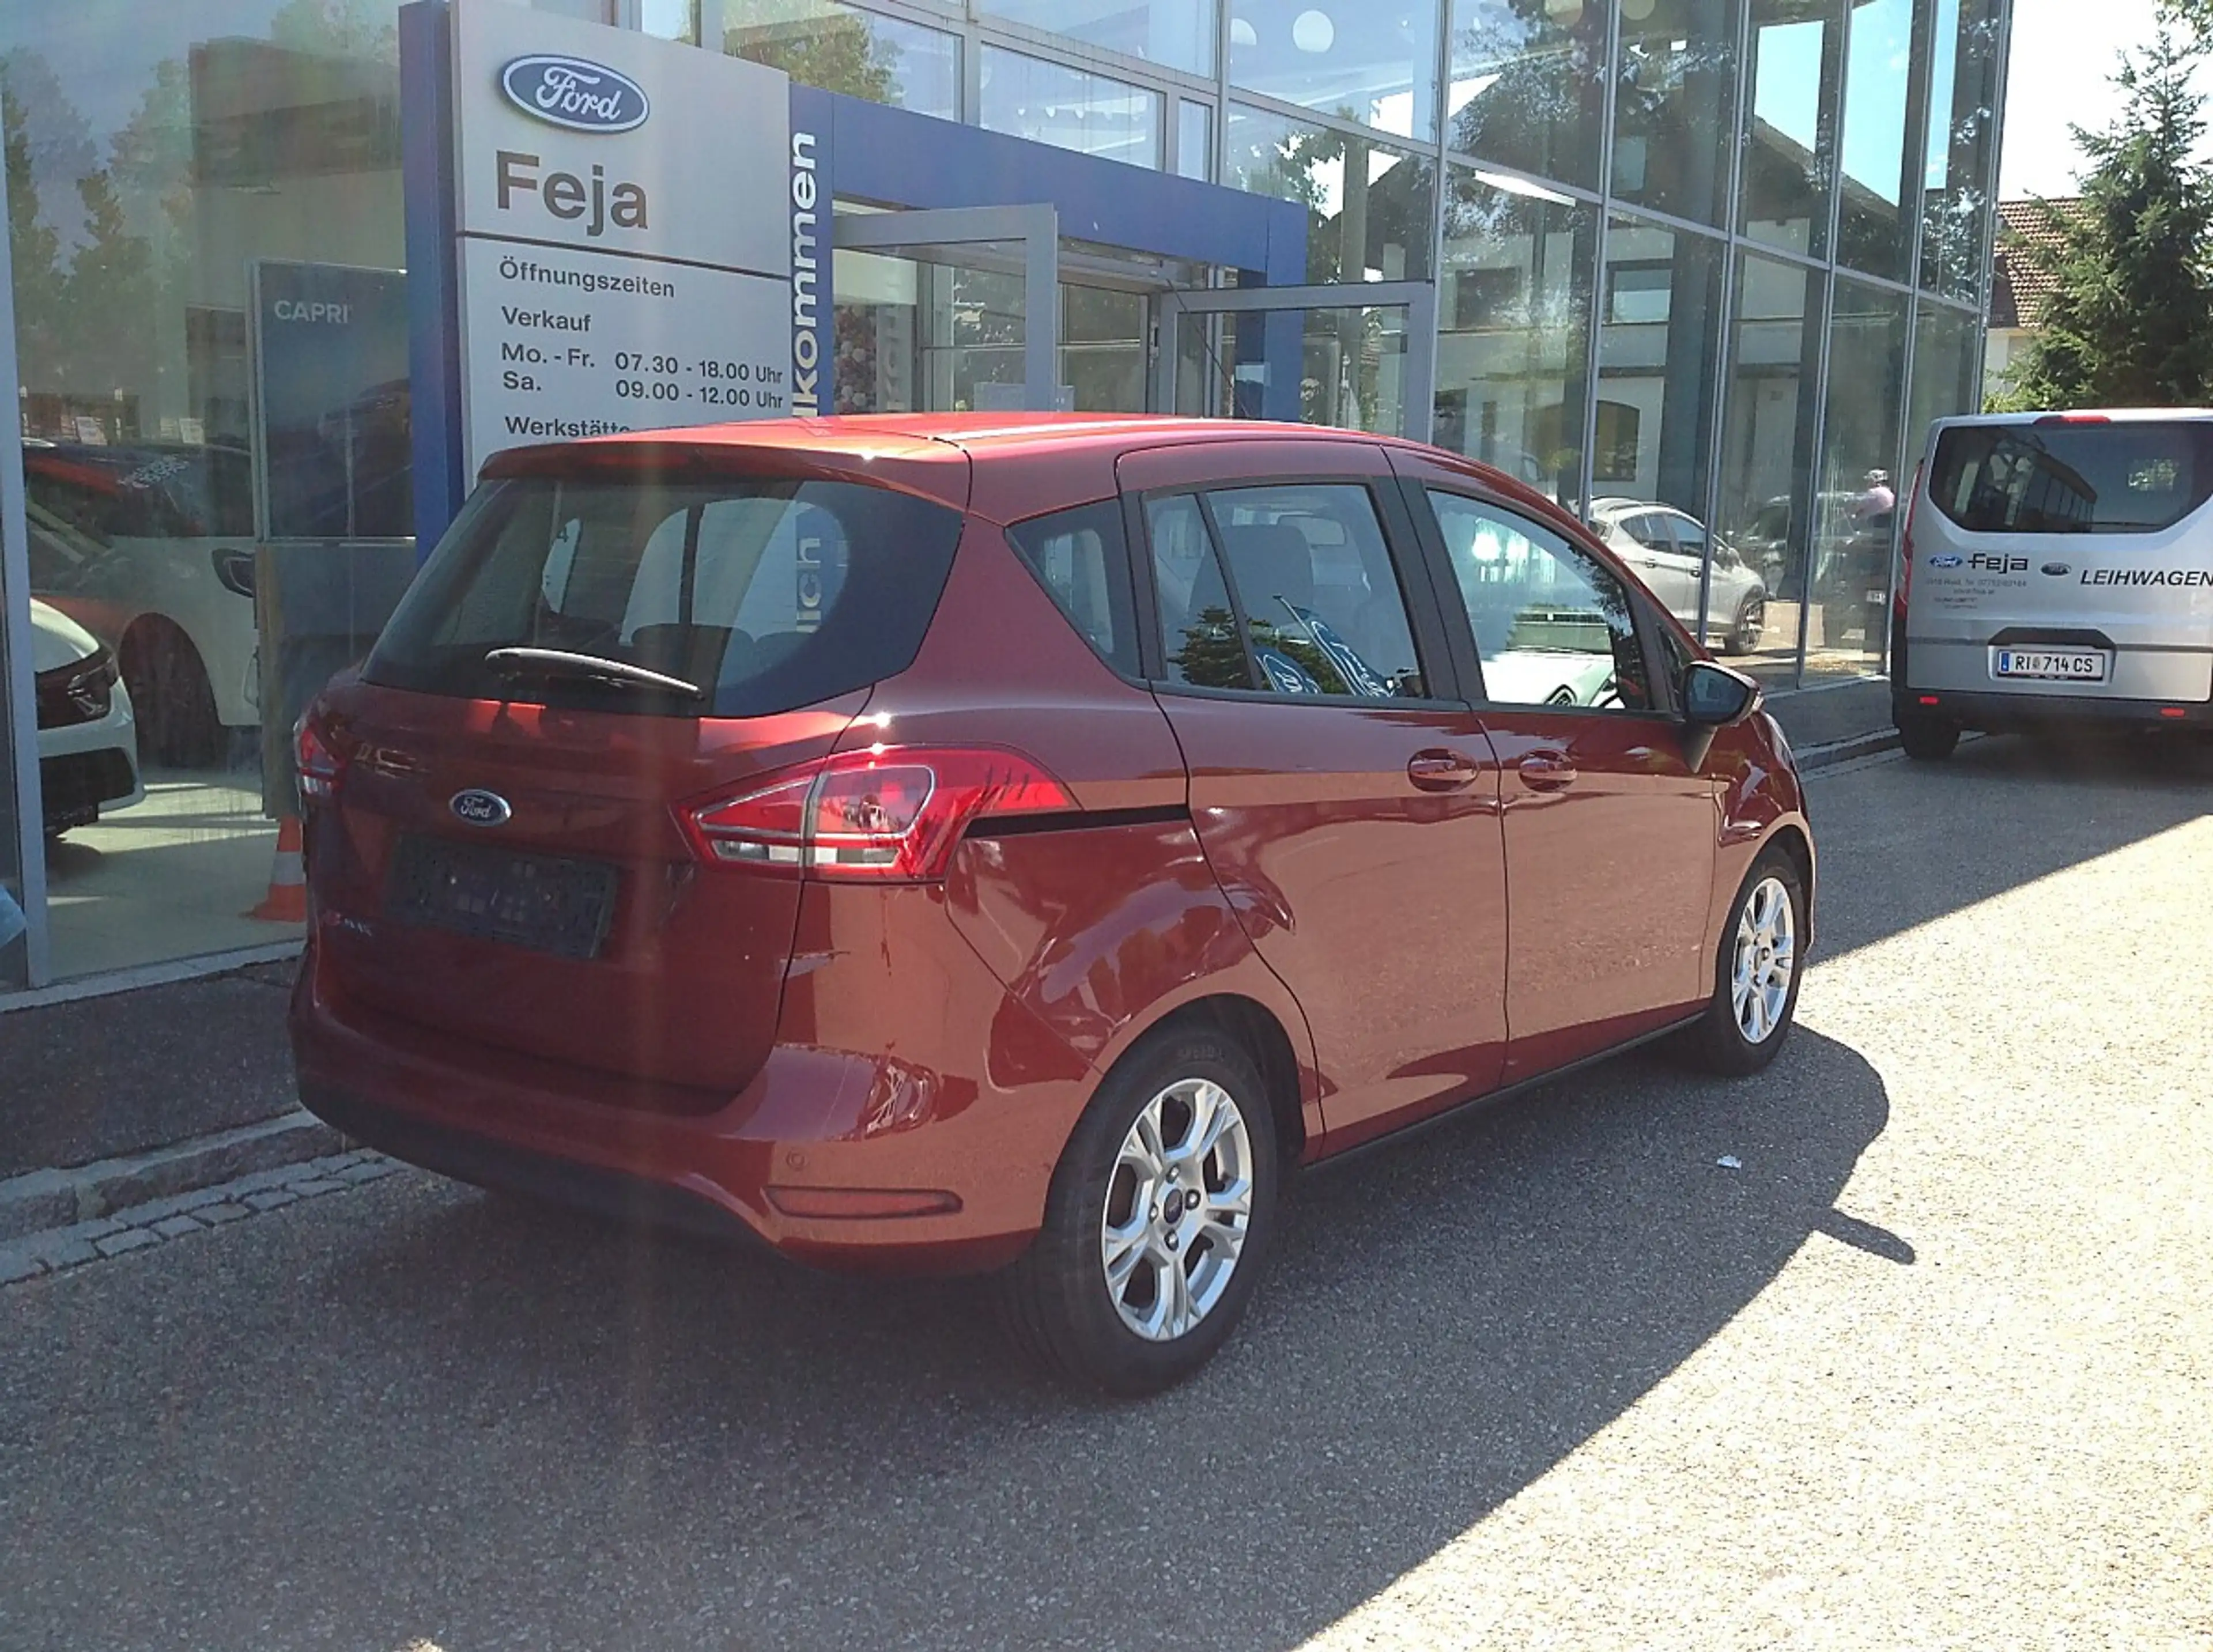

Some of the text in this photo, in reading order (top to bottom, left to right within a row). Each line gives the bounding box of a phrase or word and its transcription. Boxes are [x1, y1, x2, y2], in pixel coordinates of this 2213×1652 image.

[536, 66, 621, 121] Ford
[496, 150, 648, 236] Feja
[500, 256, 675, 297] Öffnungszeiten
[274, 300, 348, 324] CAPRI
[501, 306, 591, 332] Verkauf
[501, 342, 547, 364] Mo.
[568, 348, 595, 368] Fr.
[615, 352, 678, 374] 07.30
[699, 360, 749, 380] 18.00
[756, 365, 783, 384] Uhr
[503, 371, 542, 391] Sa.
[616, 380, 679, 400] 09.00
[699, 387, 750, 407] 12.00
[756, 391, 783, 408] Uhr
[2080, 570, 2213, 586] LEIHWAGEN
[2016, 656, 2093, 672] RI 714 CS
[460, 796, 492, 818] Ford
